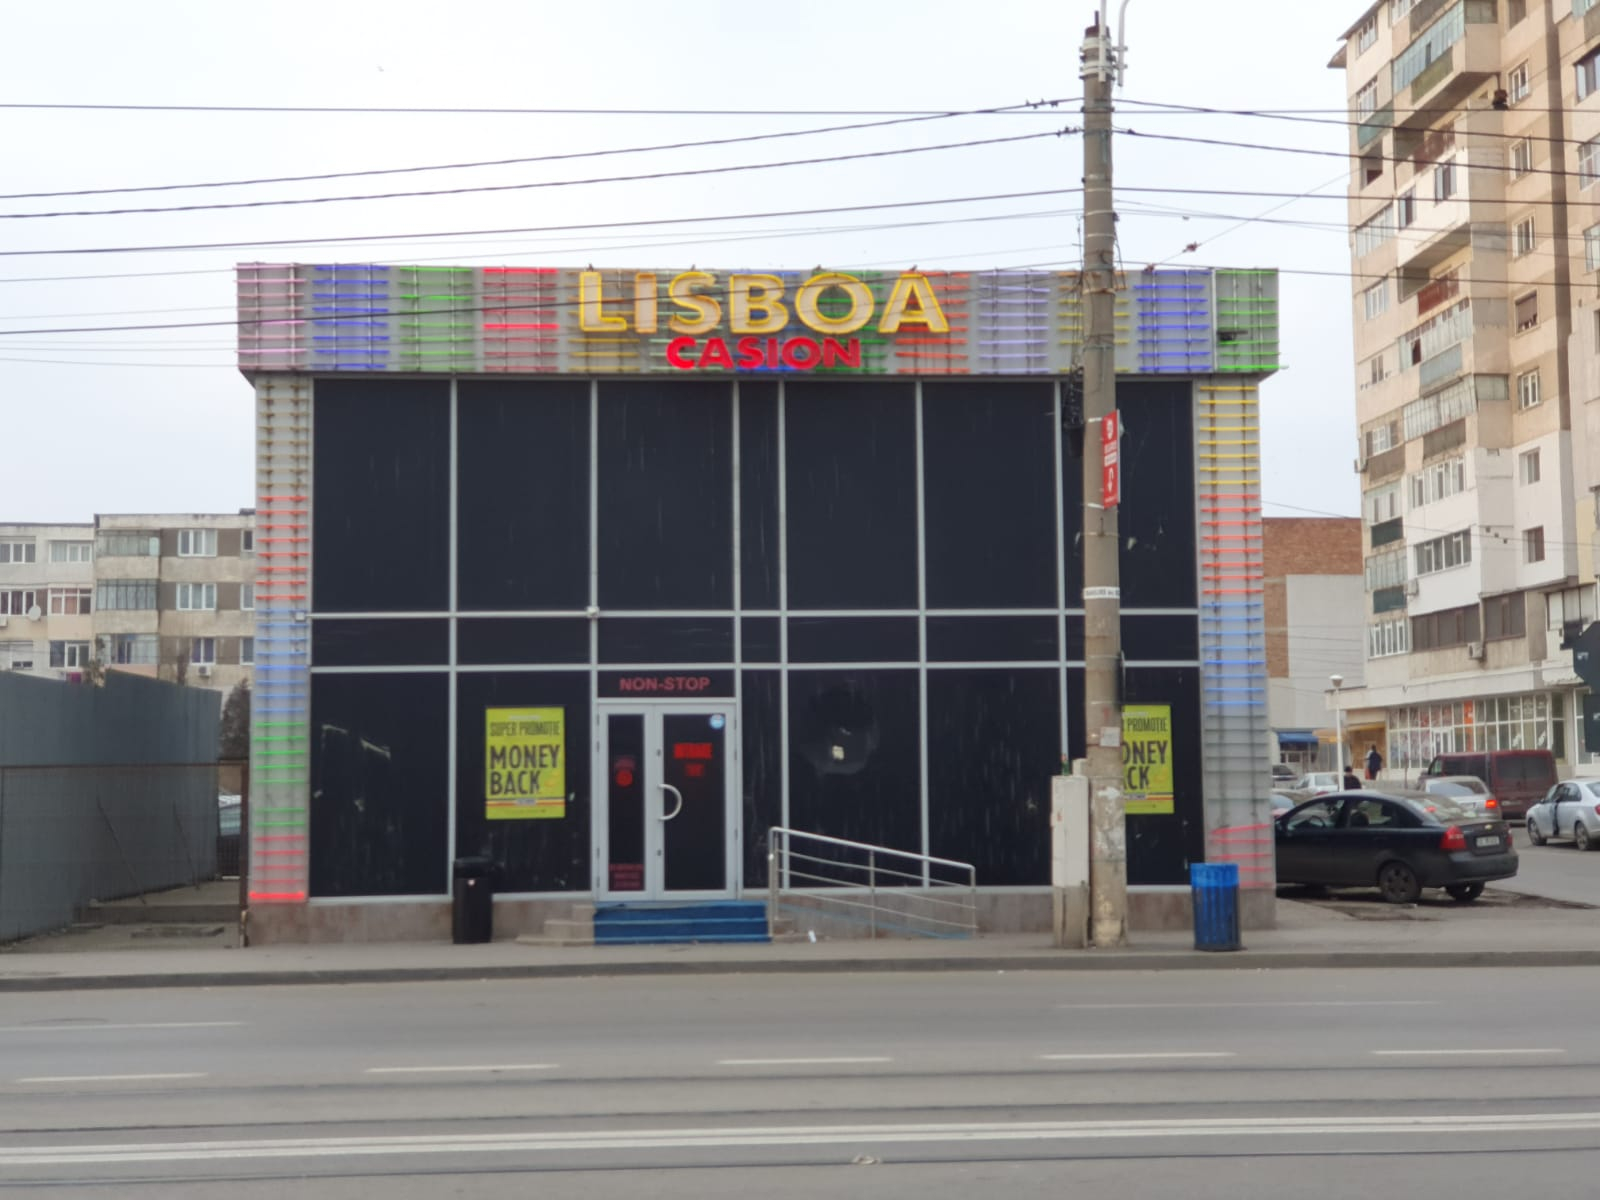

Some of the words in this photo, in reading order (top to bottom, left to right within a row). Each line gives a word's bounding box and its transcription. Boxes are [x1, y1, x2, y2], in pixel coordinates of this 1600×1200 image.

[579, 270, 950, 336] LISBOA
[666, 336, 861, 370] CASION
[619, 676, 711, 691] NON-STOP
[489, 721, 517, 737] SUPER
[489, 744, 561, 770] MONEY
[1122, 740, 1169, 765] ONEY
[489, 769, 541, 796] BACK
